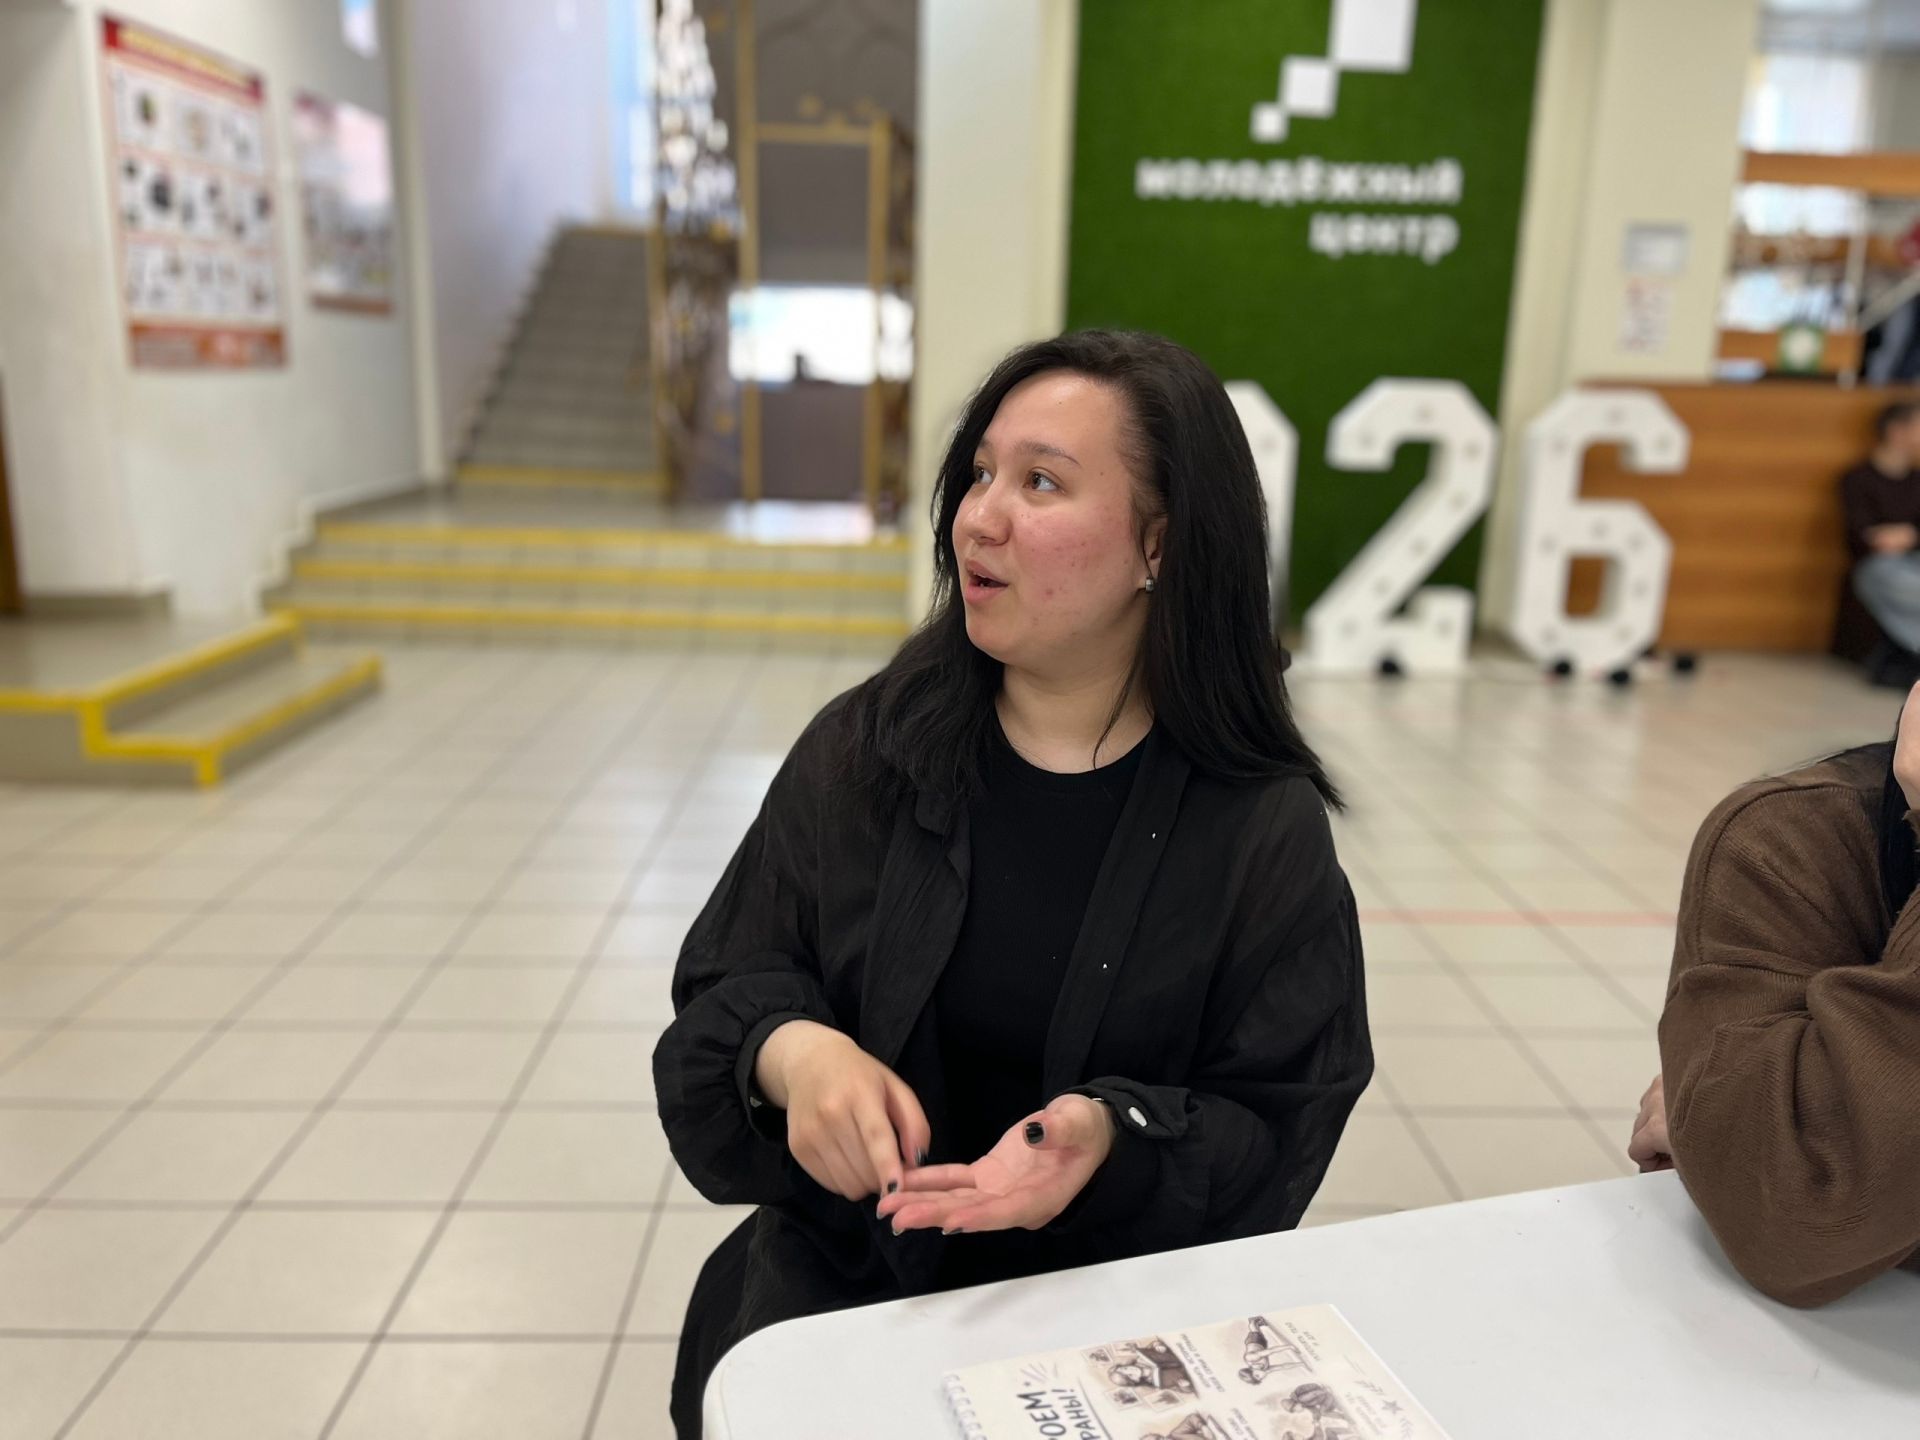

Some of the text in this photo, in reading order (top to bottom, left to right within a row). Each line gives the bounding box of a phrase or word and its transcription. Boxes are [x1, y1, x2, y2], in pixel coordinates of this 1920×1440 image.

[1136, 157, 1462, 206] молодёжный
[1309, 212, 1459, 264] центр
[1016, 1391, 1067, 1440] ОЕМ
